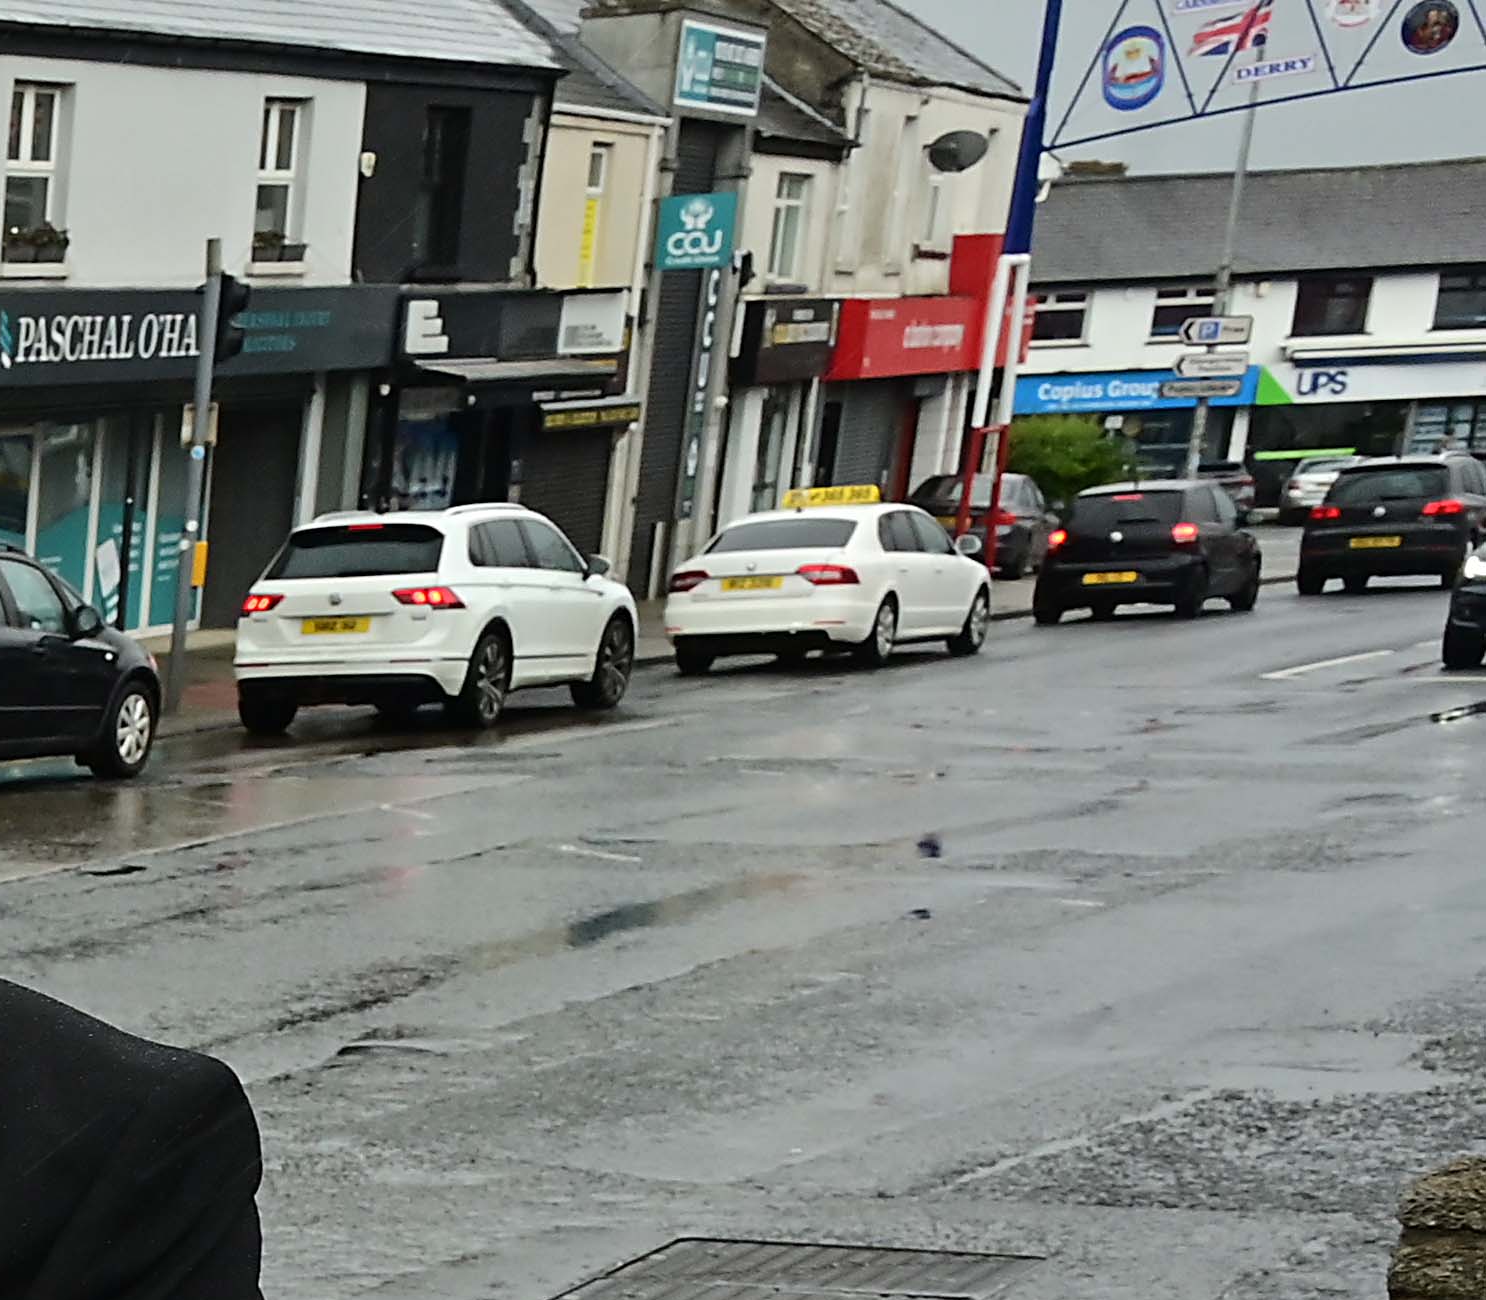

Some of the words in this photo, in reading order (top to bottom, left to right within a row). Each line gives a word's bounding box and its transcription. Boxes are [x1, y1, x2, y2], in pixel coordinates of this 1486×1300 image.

[1237, 58, 1311, 80] DERRY
[15, 315, 135, 363] PASCHAL
[138, 314, 201, 359] O'HA
